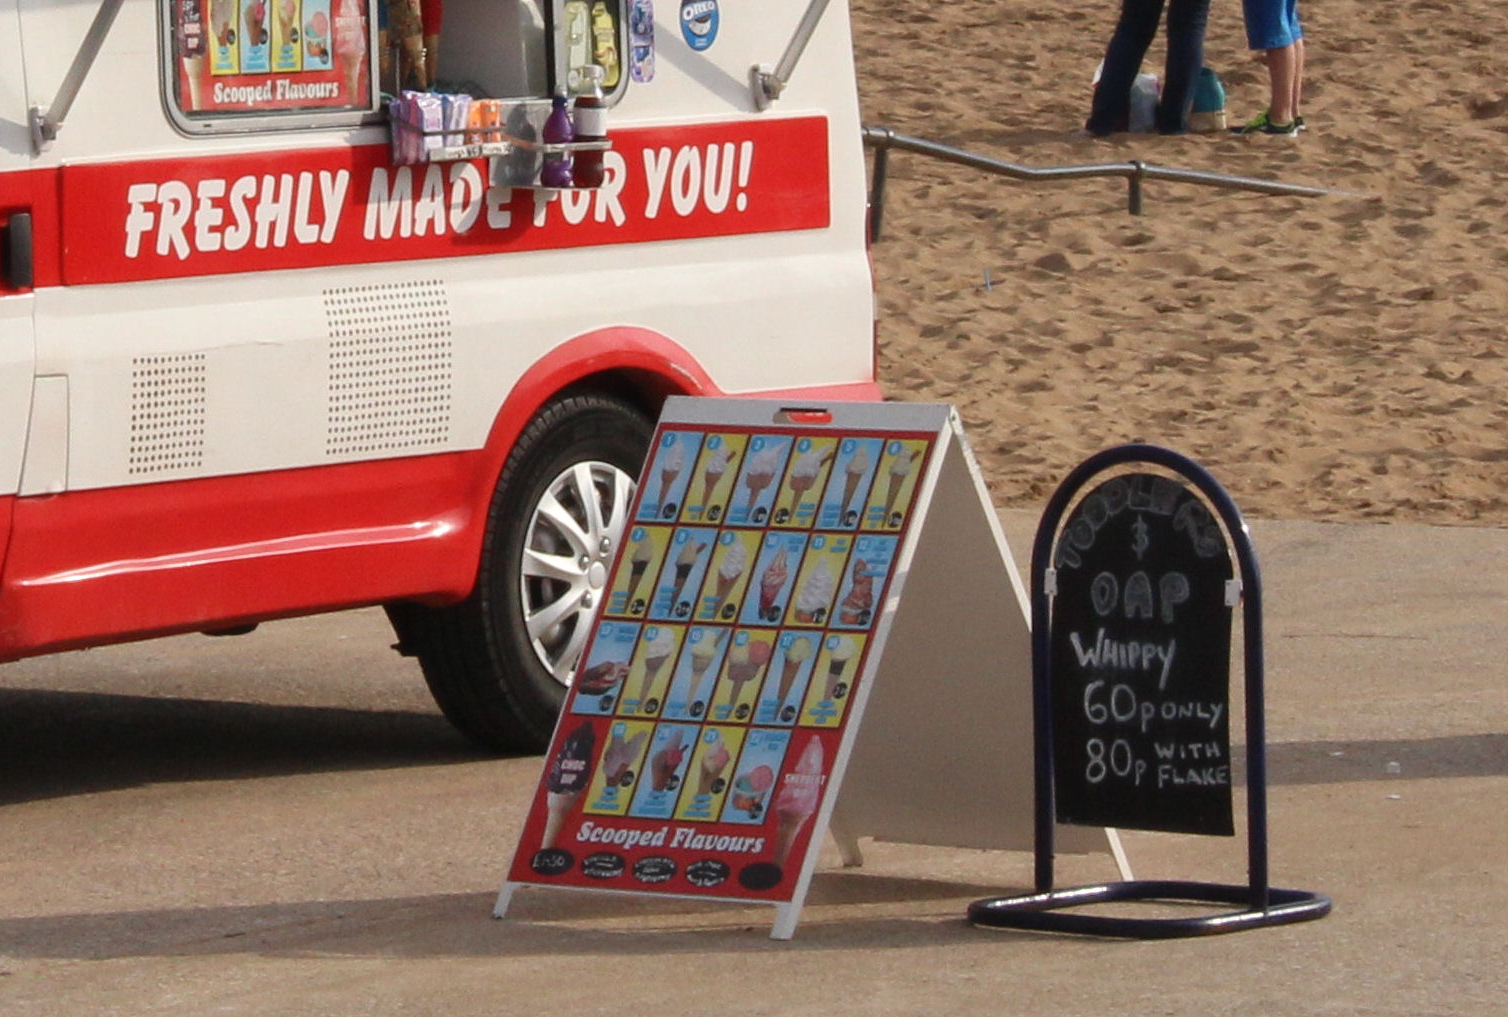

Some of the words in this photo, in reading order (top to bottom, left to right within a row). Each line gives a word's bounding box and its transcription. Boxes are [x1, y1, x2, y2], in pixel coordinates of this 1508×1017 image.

[682, 0, 715, 21] OREO
[212, 79, 272, 106] Scooped
[275, 78, 339, 101] Flavours
[124, 169, 350, 261] FRESHLY
[362, 162, 513, 241] MADE
[643, 140, 755, 219] YOU!
[1090, 571, 1190, 624] OAP
[1084, 679, 1155, 733] 60p
[1160, 702, 1224, 729] ONLY
[1085, 738, 1147, 786] 80p
[1157, 764, 1230, 789] FLAKE
[576, 821, 665, 850] Scooped
[669, 826, 766, 855] Flavours
